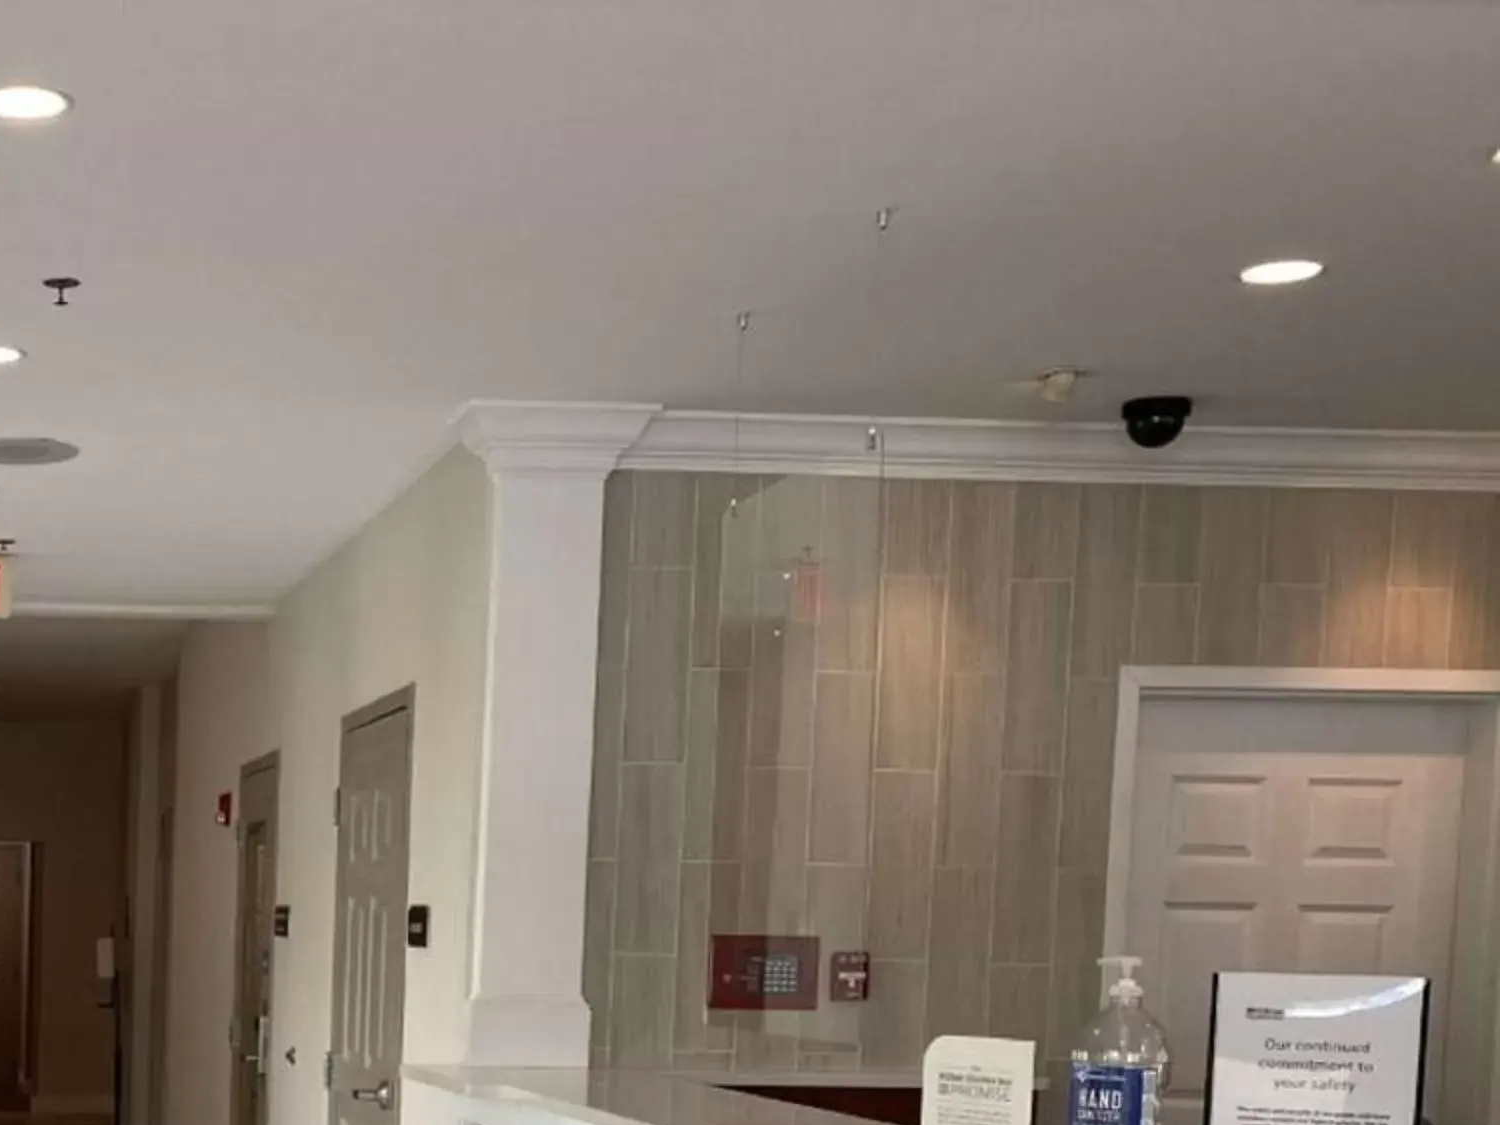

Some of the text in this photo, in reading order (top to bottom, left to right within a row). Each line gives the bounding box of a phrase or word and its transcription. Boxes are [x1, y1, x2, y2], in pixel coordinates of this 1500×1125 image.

[1264, 1038, 1370, 1053] Our continued
[1258, 1059, 1374, 1073] commitment to
[1273, 1079, 1356, 1094] your safety
[1079, 1087, 1123, 1109] HAND
